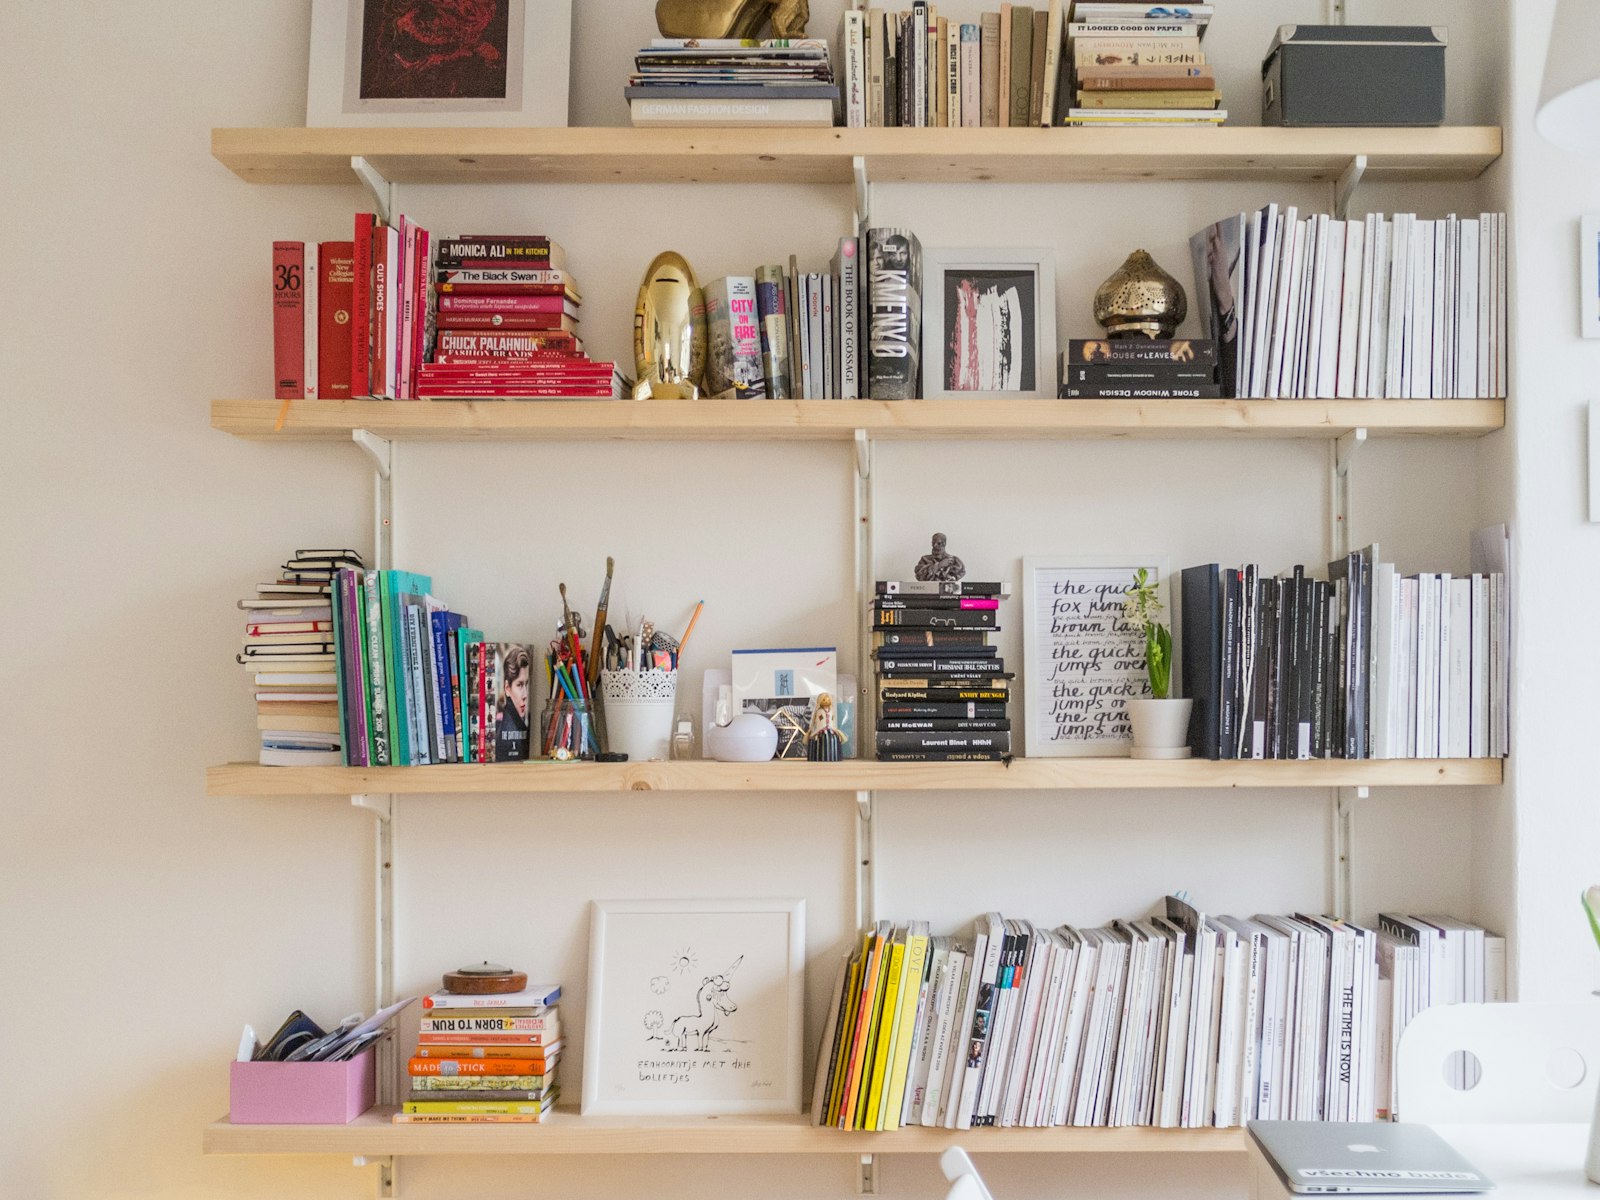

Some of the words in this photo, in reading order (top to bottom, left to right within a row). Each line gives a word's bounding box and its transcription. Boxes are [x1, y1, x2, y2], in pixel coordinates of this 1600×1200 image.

[641, 104, 687, 115] GERMAN
[687, 104, 731, 115] FASHION
[731, 104, 769, 115] DESIGN
[450, 244, 486, 257] MONICA
[490, 245, 505, 258] ALI
[275, 264, 300, 291] 36
[329, 270, 354, 278] Collegiat
[376, 264, 384, 282] CULT
[462, 272, 480, 281] The
[482, 272, 508, 281] Black
[510, 272, 538, 281] Swan
[845, 265, 854, 286] THE
[376, 284, 384, 311] SHOES
[845, 289, 854, 318] BOOK
[732, 299, 753, 313] CITY
[738, 315, 748, 325] ON
[734, 325, 756, 340] FIRE
[845, 322, 854, 335] OF
[442, 337, 476, 350] CHUCK
[480, 337, 538, 351] PALAHNIUK
[845, 338, 854, 384] GOSSAGE
[1053, 580, 1090, 595] the
[1051, 600, 1084, 616] fox
[1052, 646, 1082, 660] the
[1088, 645, 1140, 662] quick
[1047, 660, 1102, 681] jumps
[1052, 684, 1083, 698] the
[1088, 683, 1136, 701] quick
[1049, 698, 1102, 715] jumps
[1055, 711, 1087, 723] the
[1094, 711, 1130, 727] quic
[1050, 722, 1105, 740] jumps
[1112, 724, 1133, 734] ove
[910, 938, 924, 974] LOVE
[1251, 934, 1259, 978] Wonderland.
[1343, 986, 1353, 1008] THE
[432, 1020, 455, 1030] RUN
[458, 1020, 473, 1030] TO
[476, 1020, 503, 1030] BORN
[1341, 1011, 1352, 1037] TIME
[1341, 1039, 1351, 1050] IS
[414, 1064, 441, 1072] MADE
[457, 1064, 485, 1072] STICK
[702, 1060, 726, 1069] MET
[1340, 1054, 1350, 1083] NOW
[1304, 1170, 1400, 1178] všechno
